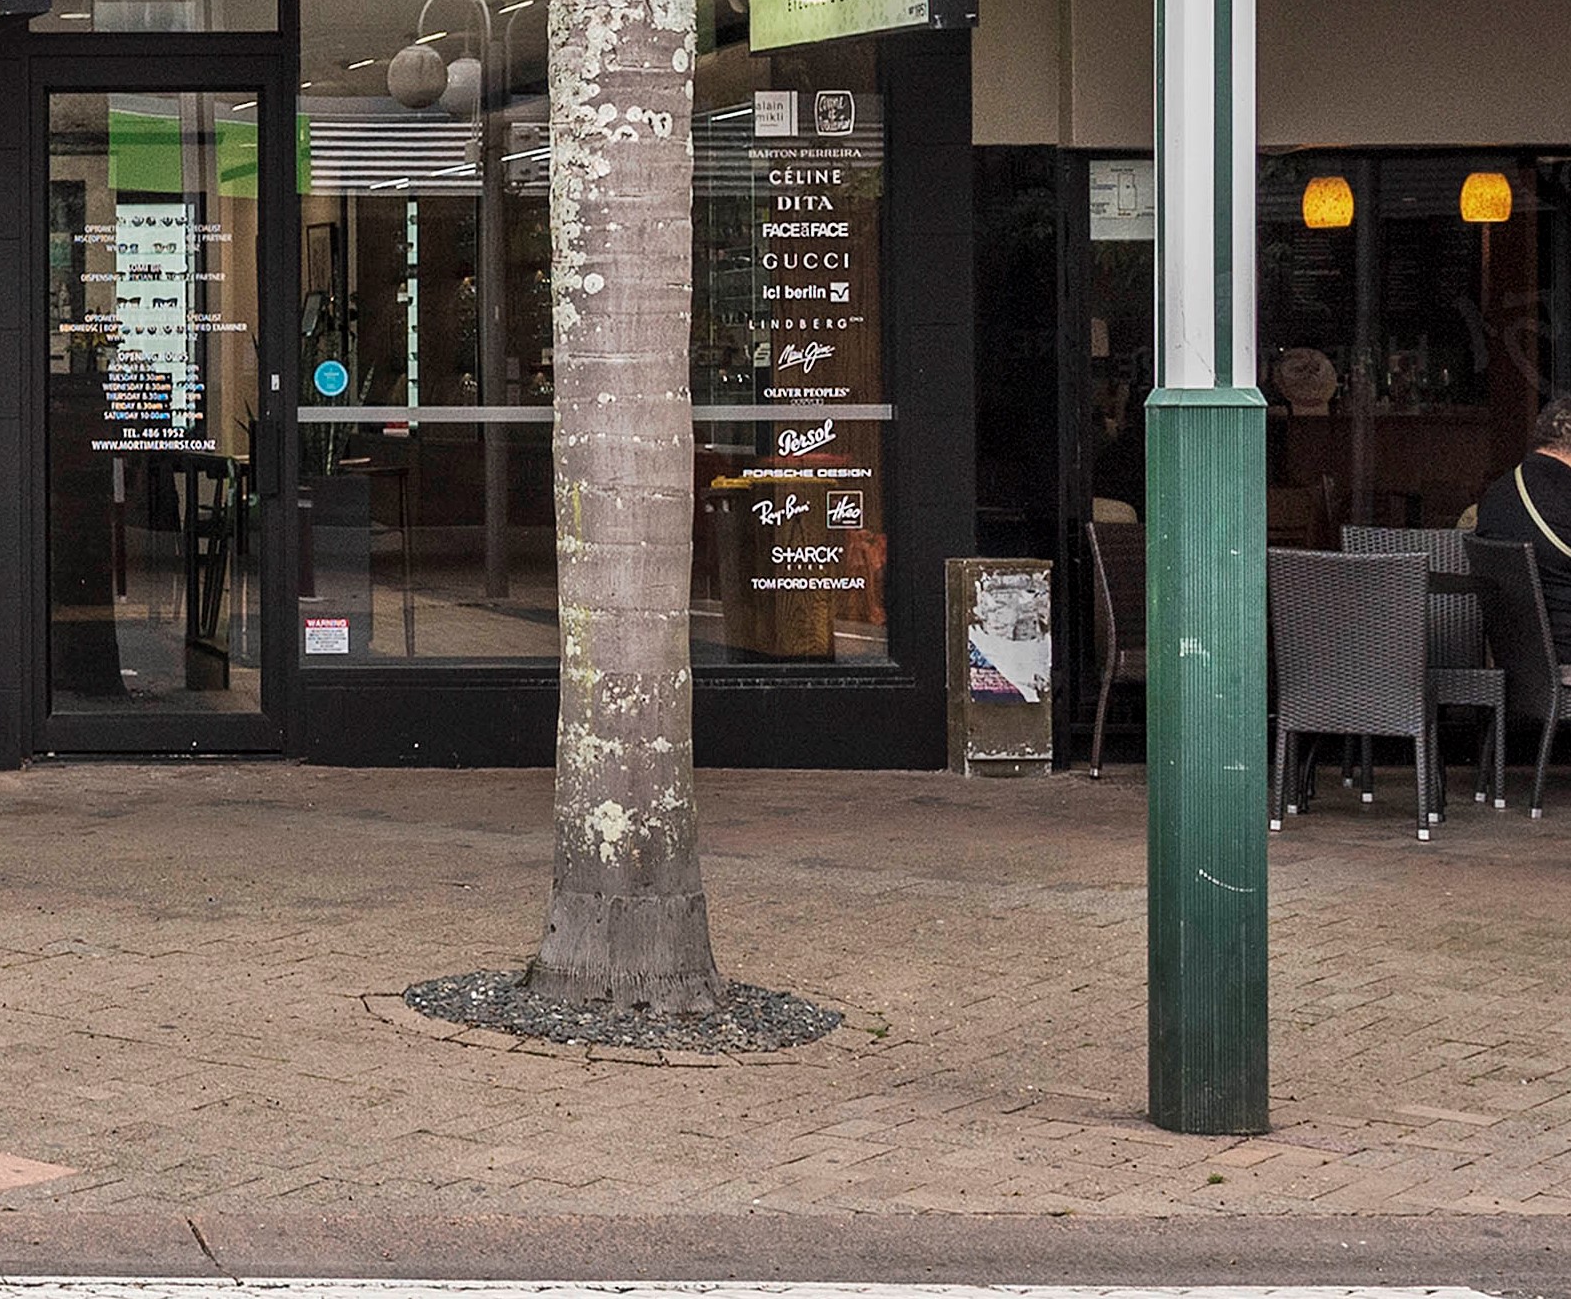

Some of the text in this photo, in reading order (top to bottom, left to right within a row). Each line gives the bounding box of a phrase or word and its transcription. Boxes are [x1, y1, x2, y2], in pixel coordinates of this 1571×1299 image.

[769, 166, 842, 185] CÉLINE
[777, 196, 834, 211] DITA
[762, 252, 850, 269] GUCCI
[784, 285, 827, 300] berlin
[749, 318, 848, 331] LINDBERG
[763, 388, 802, 398] OLIVER
[778, 418, 836, 457] Persol
[743, 468, 872, 478] PORSCHE DESIGN
[751, 578, 865, 590] TOM FORD EYEWEAR
